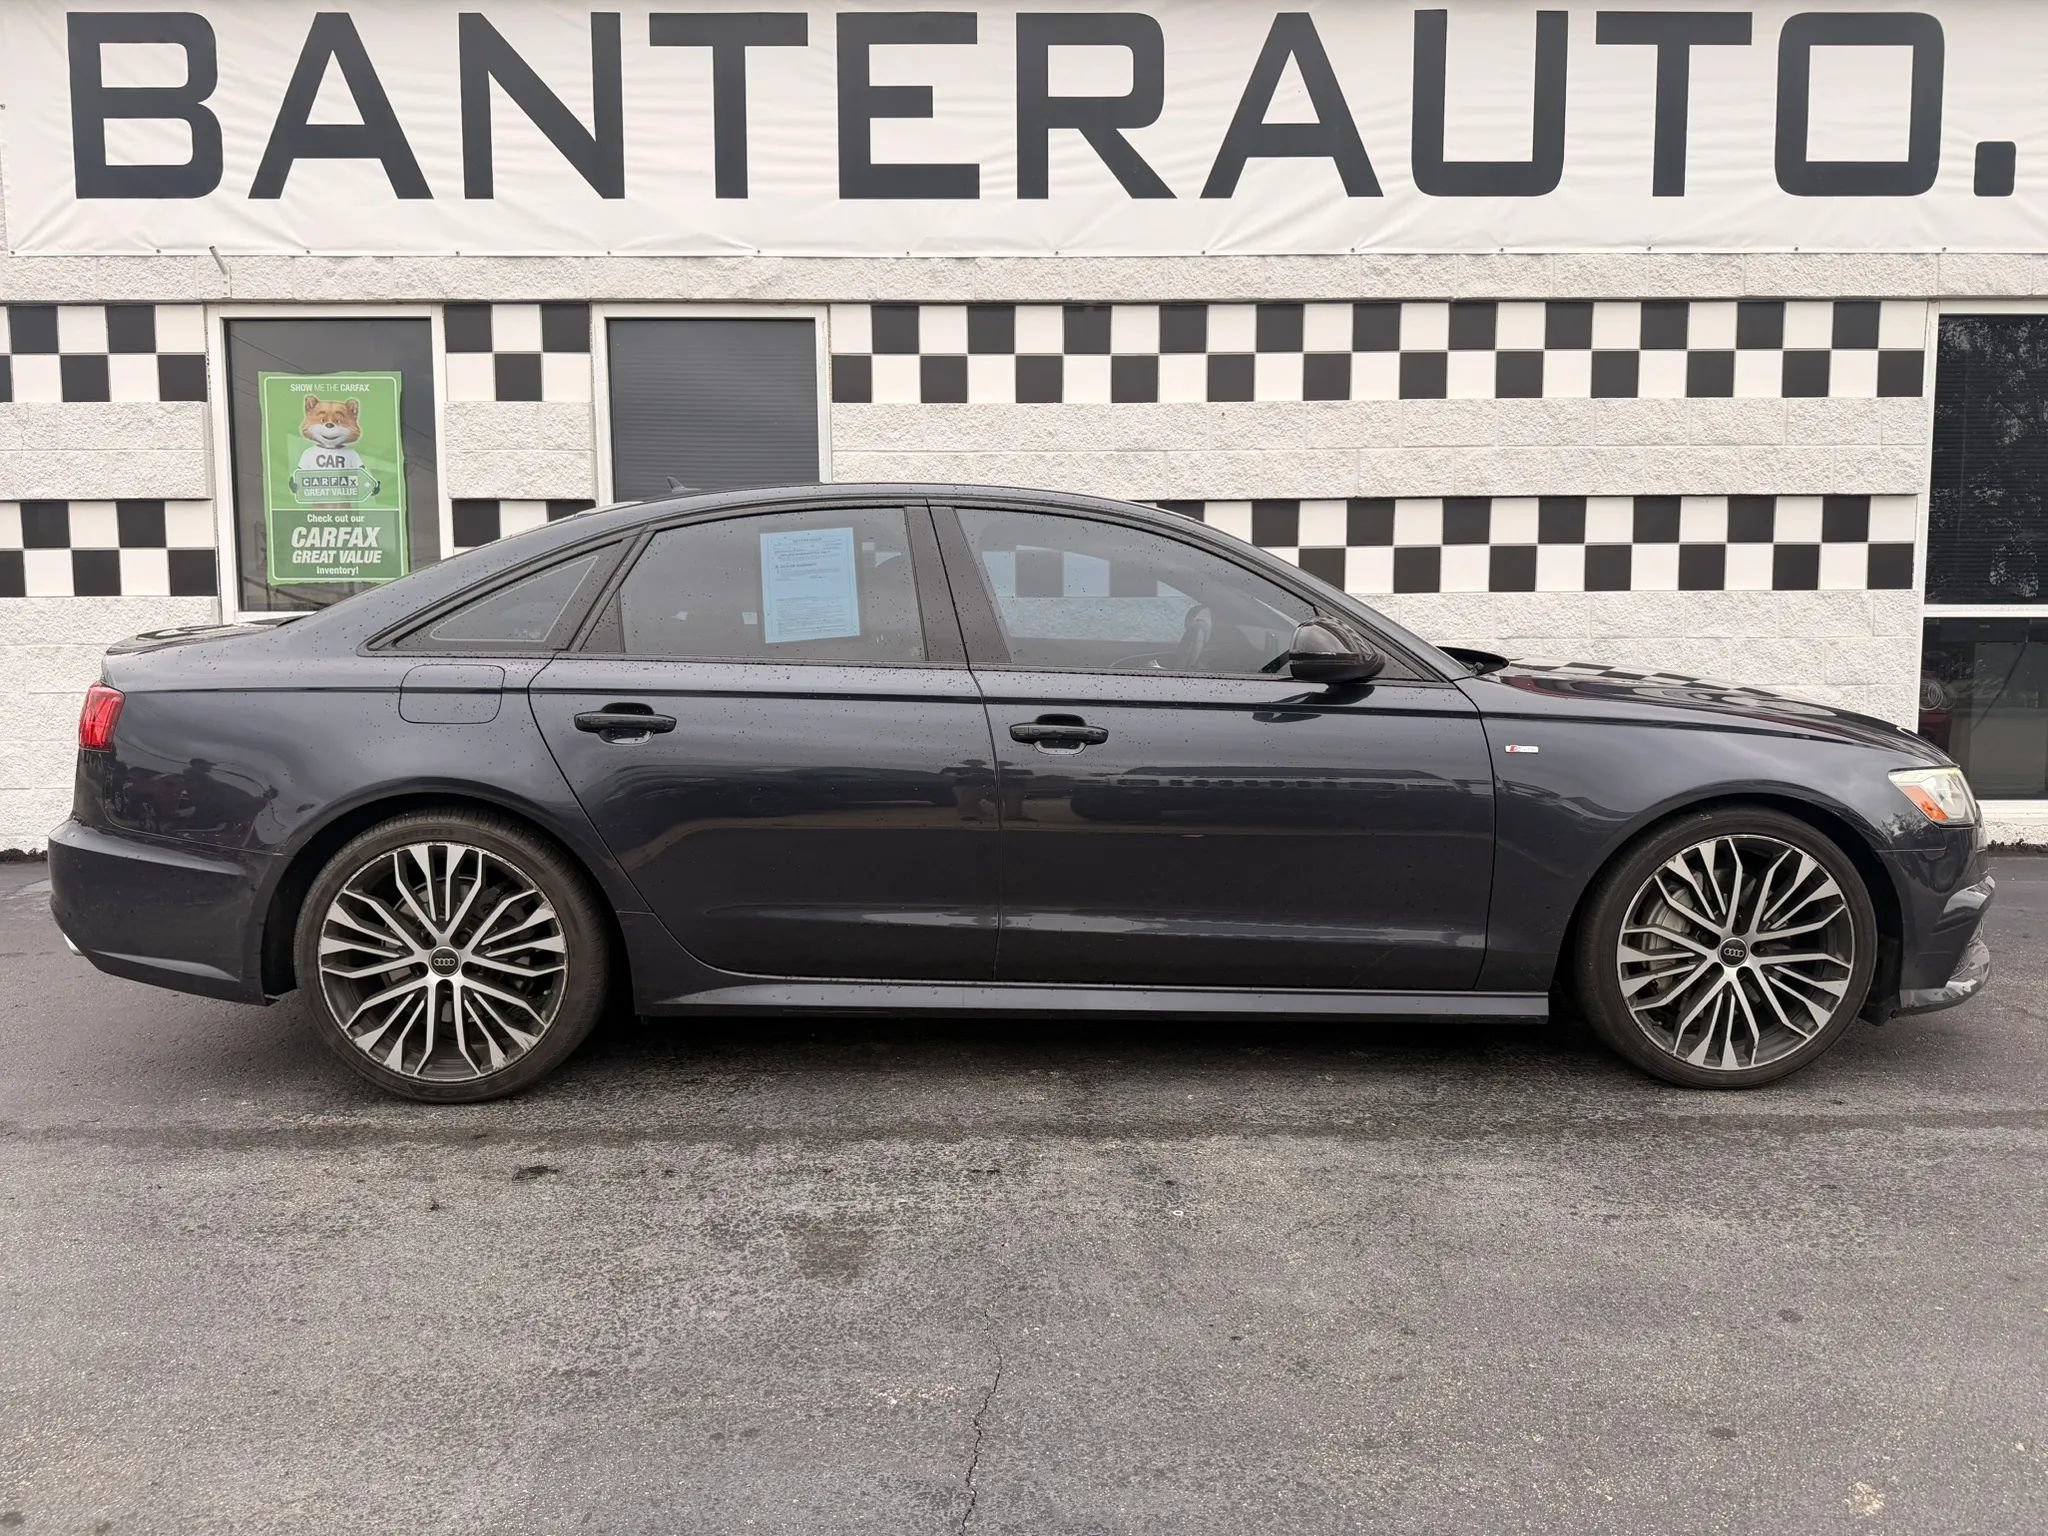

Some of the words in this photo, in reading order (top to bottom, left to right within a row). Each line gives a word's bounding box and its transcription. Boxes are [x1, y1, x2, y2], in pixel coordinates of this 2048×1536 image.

[67, 10, 2016, 200] BANTERAUTO.
[290, 383, 313, 392] SHOW
[314, 383, 325, 392] ME
[326, 383, 339, 392] THE
[340, 383, 370, 392] CARFAX
[316, 454, 346, 468] CAR
[302, 477, 358, 487] CARFAX
[303, 488, 331, 497] GREAT
[332, 488, 358, 496] VALUE
[307, 513, 333, 523] Check
[334, 513, 348, 523] out
[350, 515, 365, 523] our
[291, 526, 381, 548] CARFAX
[292, 550, 337, 564] GREAT
[339, 550, 383, 564] VALUE
[316, 566, 359, 576] Inventory!
